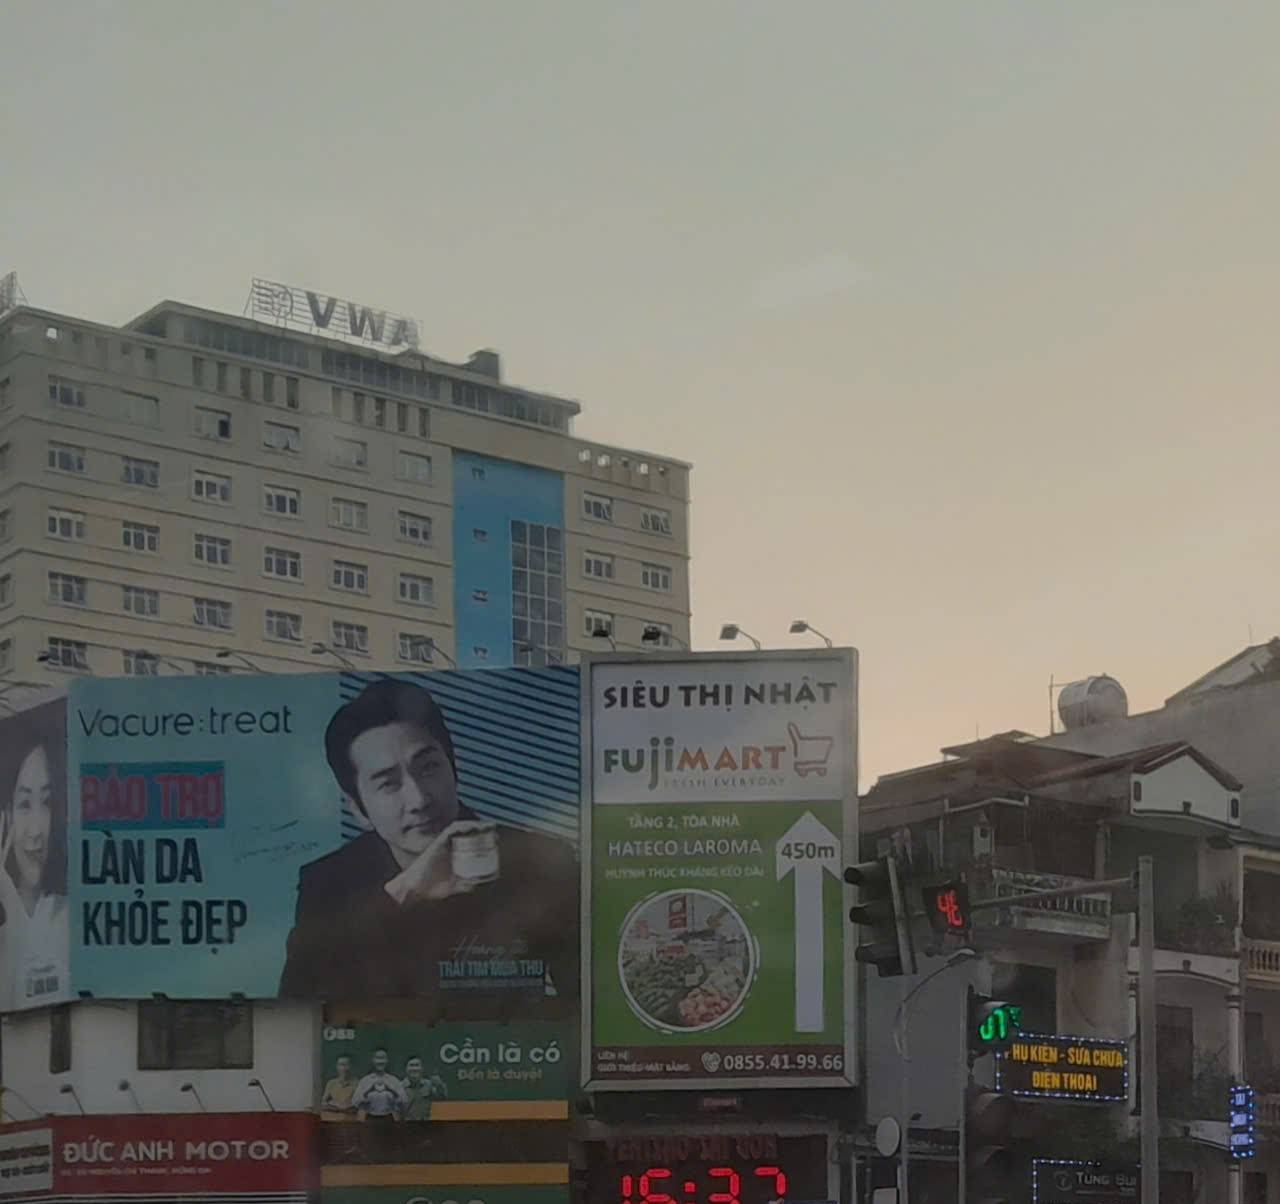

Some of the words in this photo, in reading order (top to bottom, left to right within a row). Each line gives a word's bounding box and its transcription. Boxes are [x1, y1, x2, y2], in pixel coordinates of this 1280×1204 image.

[603, 680, 670, 709] SIÊU
[678, 684, 733, 712] THỊ
[743, 676, 837, 711] NHẬT
[712, 811, 740, 827] NHÀ
[81, 829, 144, 885] LÀN
[155, 838, 203, 884] DA
[608, 839, 679, 857] HATECO
[684, 839, 762, 856] LAROMA
[781, 842, 835, 860] 450m
[83, 889, 170, 946] KHỎE
[180, 899, 248, 955] ĐẸP
[439, 1037, 491, 1064] Cần
[497, 1040, 522, 1064] là
[529, 1040, 562, 1064] có
[724, 1053, 843, 1071] 0855.41.99.66
[63, 1134, 115, 1163] ĐỨC
[121, 1140, 174, 1162] ANH
[185, 1140, 289, 1162] MOTOR
